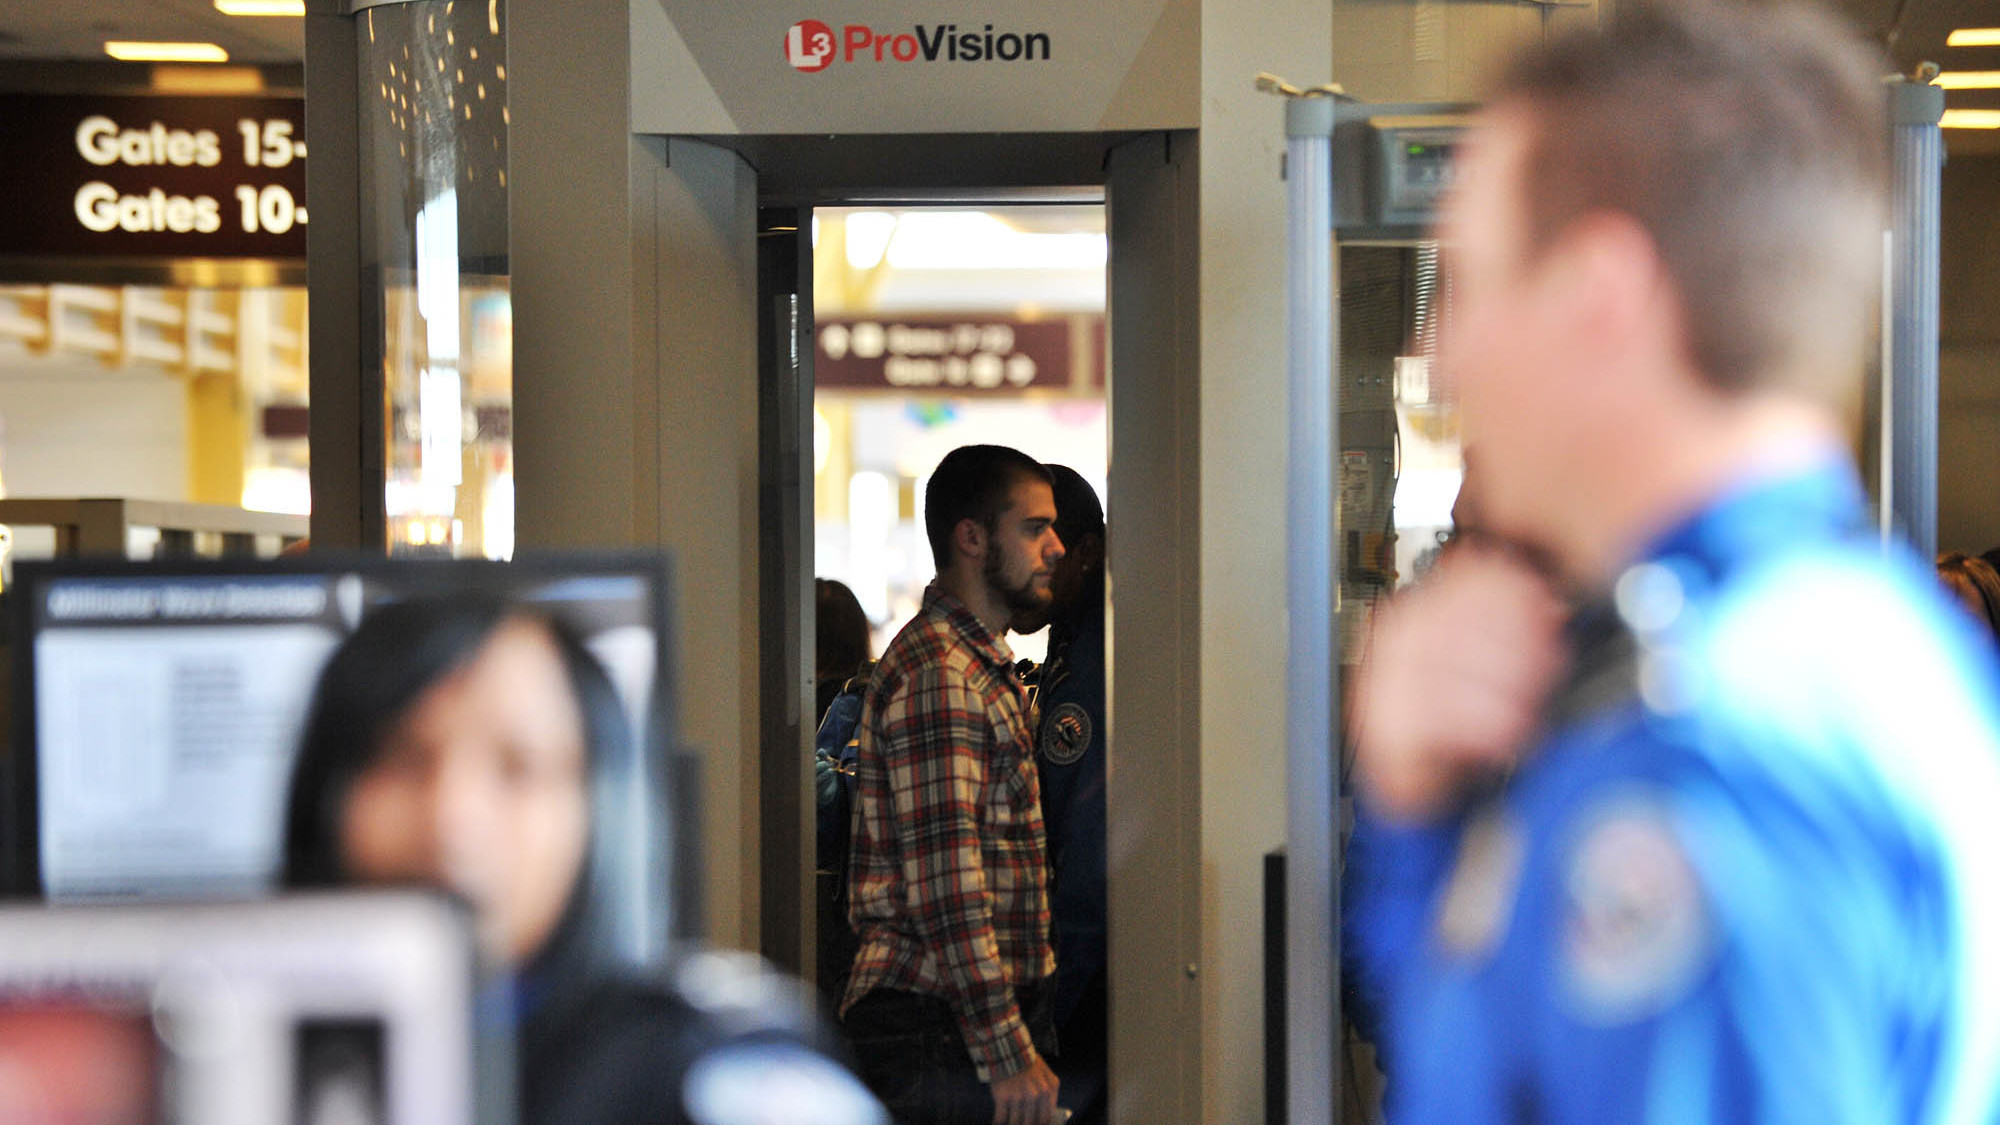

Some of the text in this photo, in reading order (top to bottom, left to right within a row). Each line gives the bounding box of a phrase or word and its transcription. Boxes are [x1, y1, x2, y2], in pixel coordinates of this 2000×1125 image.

[843, 25, 1050, 62] ProVision
[75, 115, 221, 166] Gates
[74, 181, 221, 232] Gates
